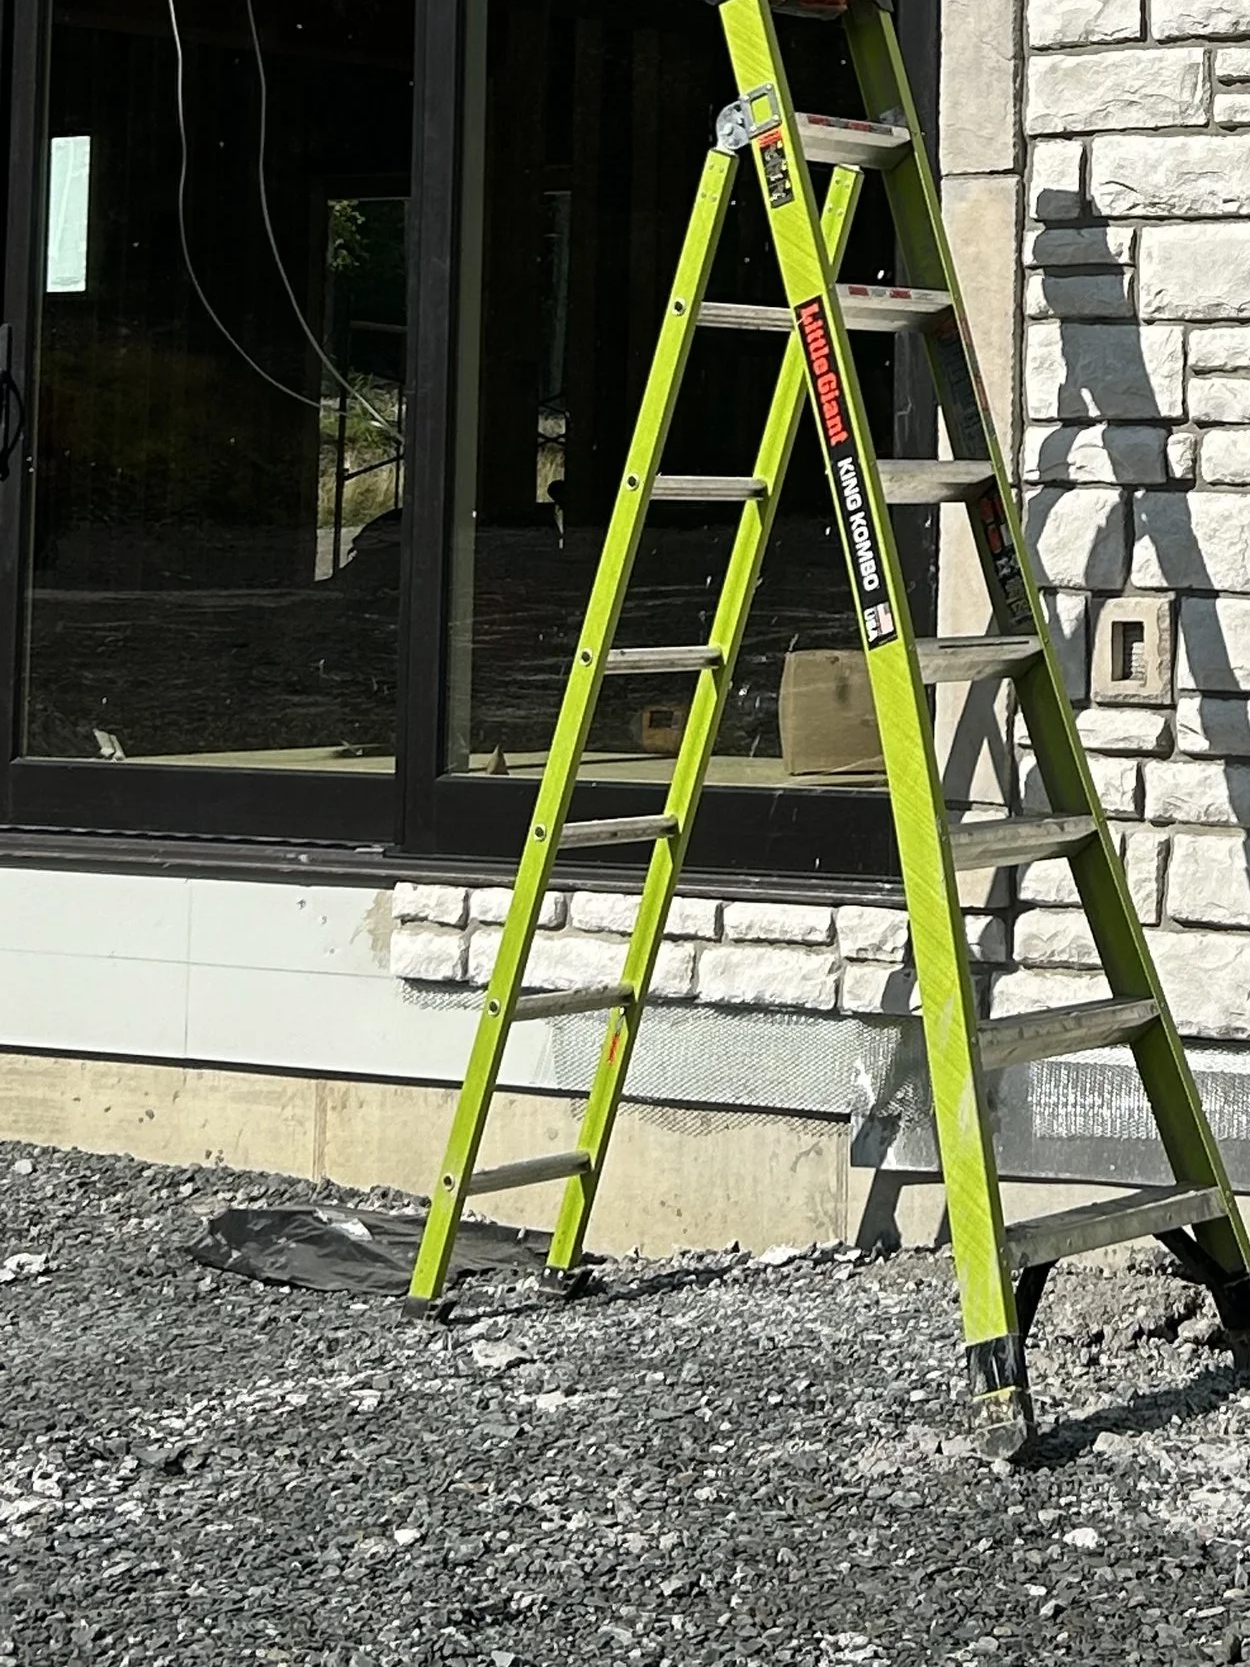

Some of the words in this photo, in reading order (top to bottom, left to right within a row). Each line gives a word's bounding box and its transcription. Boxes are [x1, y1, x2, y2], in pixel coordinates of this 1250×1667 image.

[838, 456, 863, 511] KING
[850, 511, 880, 592] KOMBO
[863, 606, 879, 643] USA
